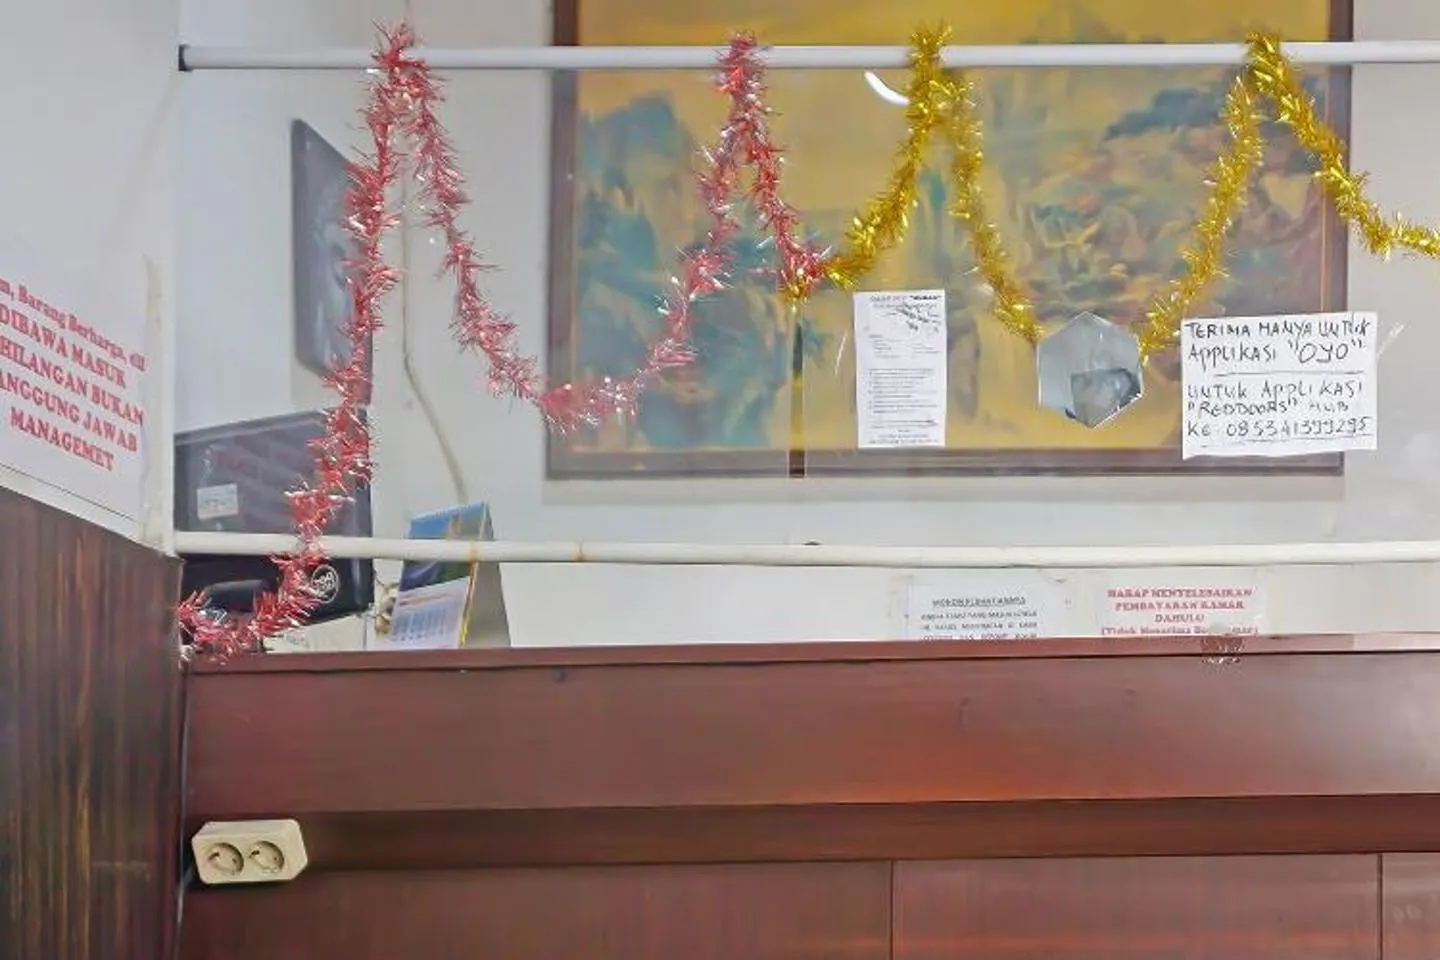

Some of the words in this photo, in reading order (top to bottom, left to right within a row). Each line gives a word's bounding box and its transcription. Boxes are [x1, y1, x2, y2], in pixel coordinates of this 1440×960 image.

[0, 303, 68, 358] DIBAWA
[72, 343, 126, 389] MASUK
[1185, 322, 1251, 339] TERIMA
[1258, 319, 1313, 344] HANYA
[92, 384, 144, 426] BUKAN
[1187, 381, 1248, 399] UNTUK
[84, 411, 138, 453] JAWAB
[1107, 588, 1150, 598] HARAP
